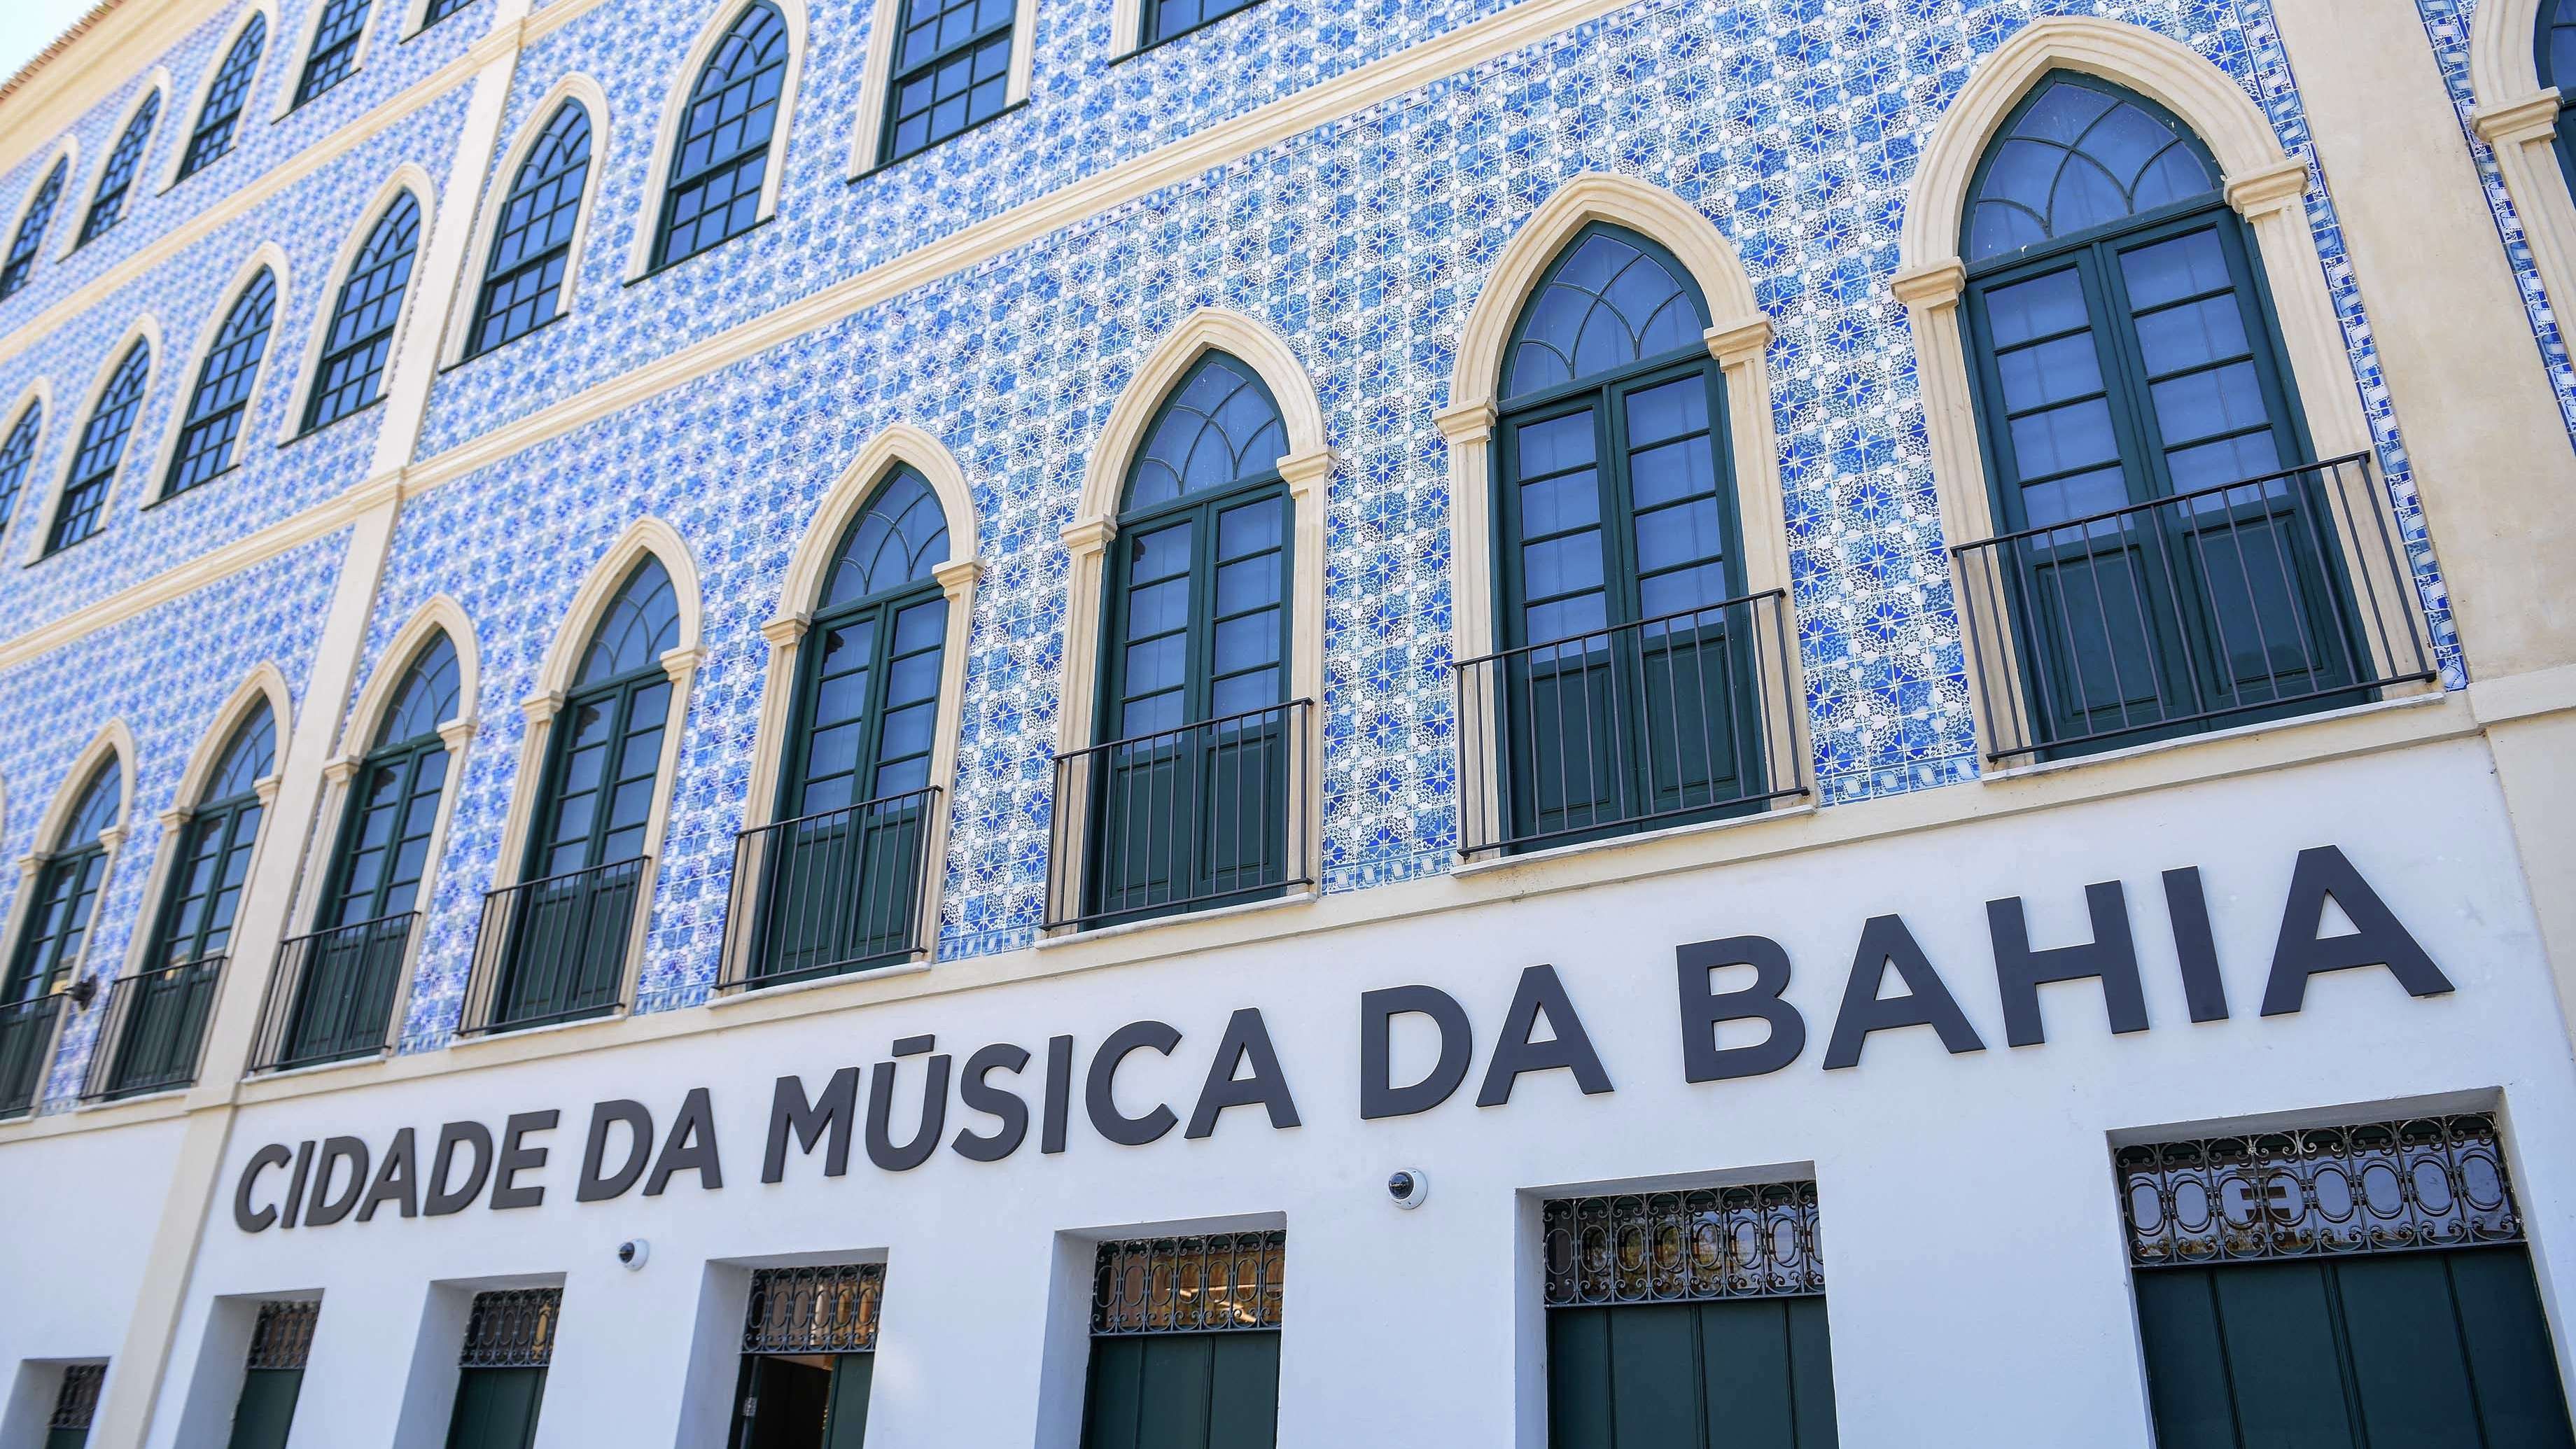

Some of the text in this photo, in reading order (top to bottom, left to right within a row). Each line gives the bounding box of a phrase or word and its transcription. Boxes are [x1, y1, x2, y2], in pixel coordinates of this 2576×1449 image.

[233, 1107, 562, 1235] CIDADE
[575, 1086, 724, 1204] DA
[1359, 962, 1616, 1121] DA
[1674, 844, 2457, 1085] BAHIA
